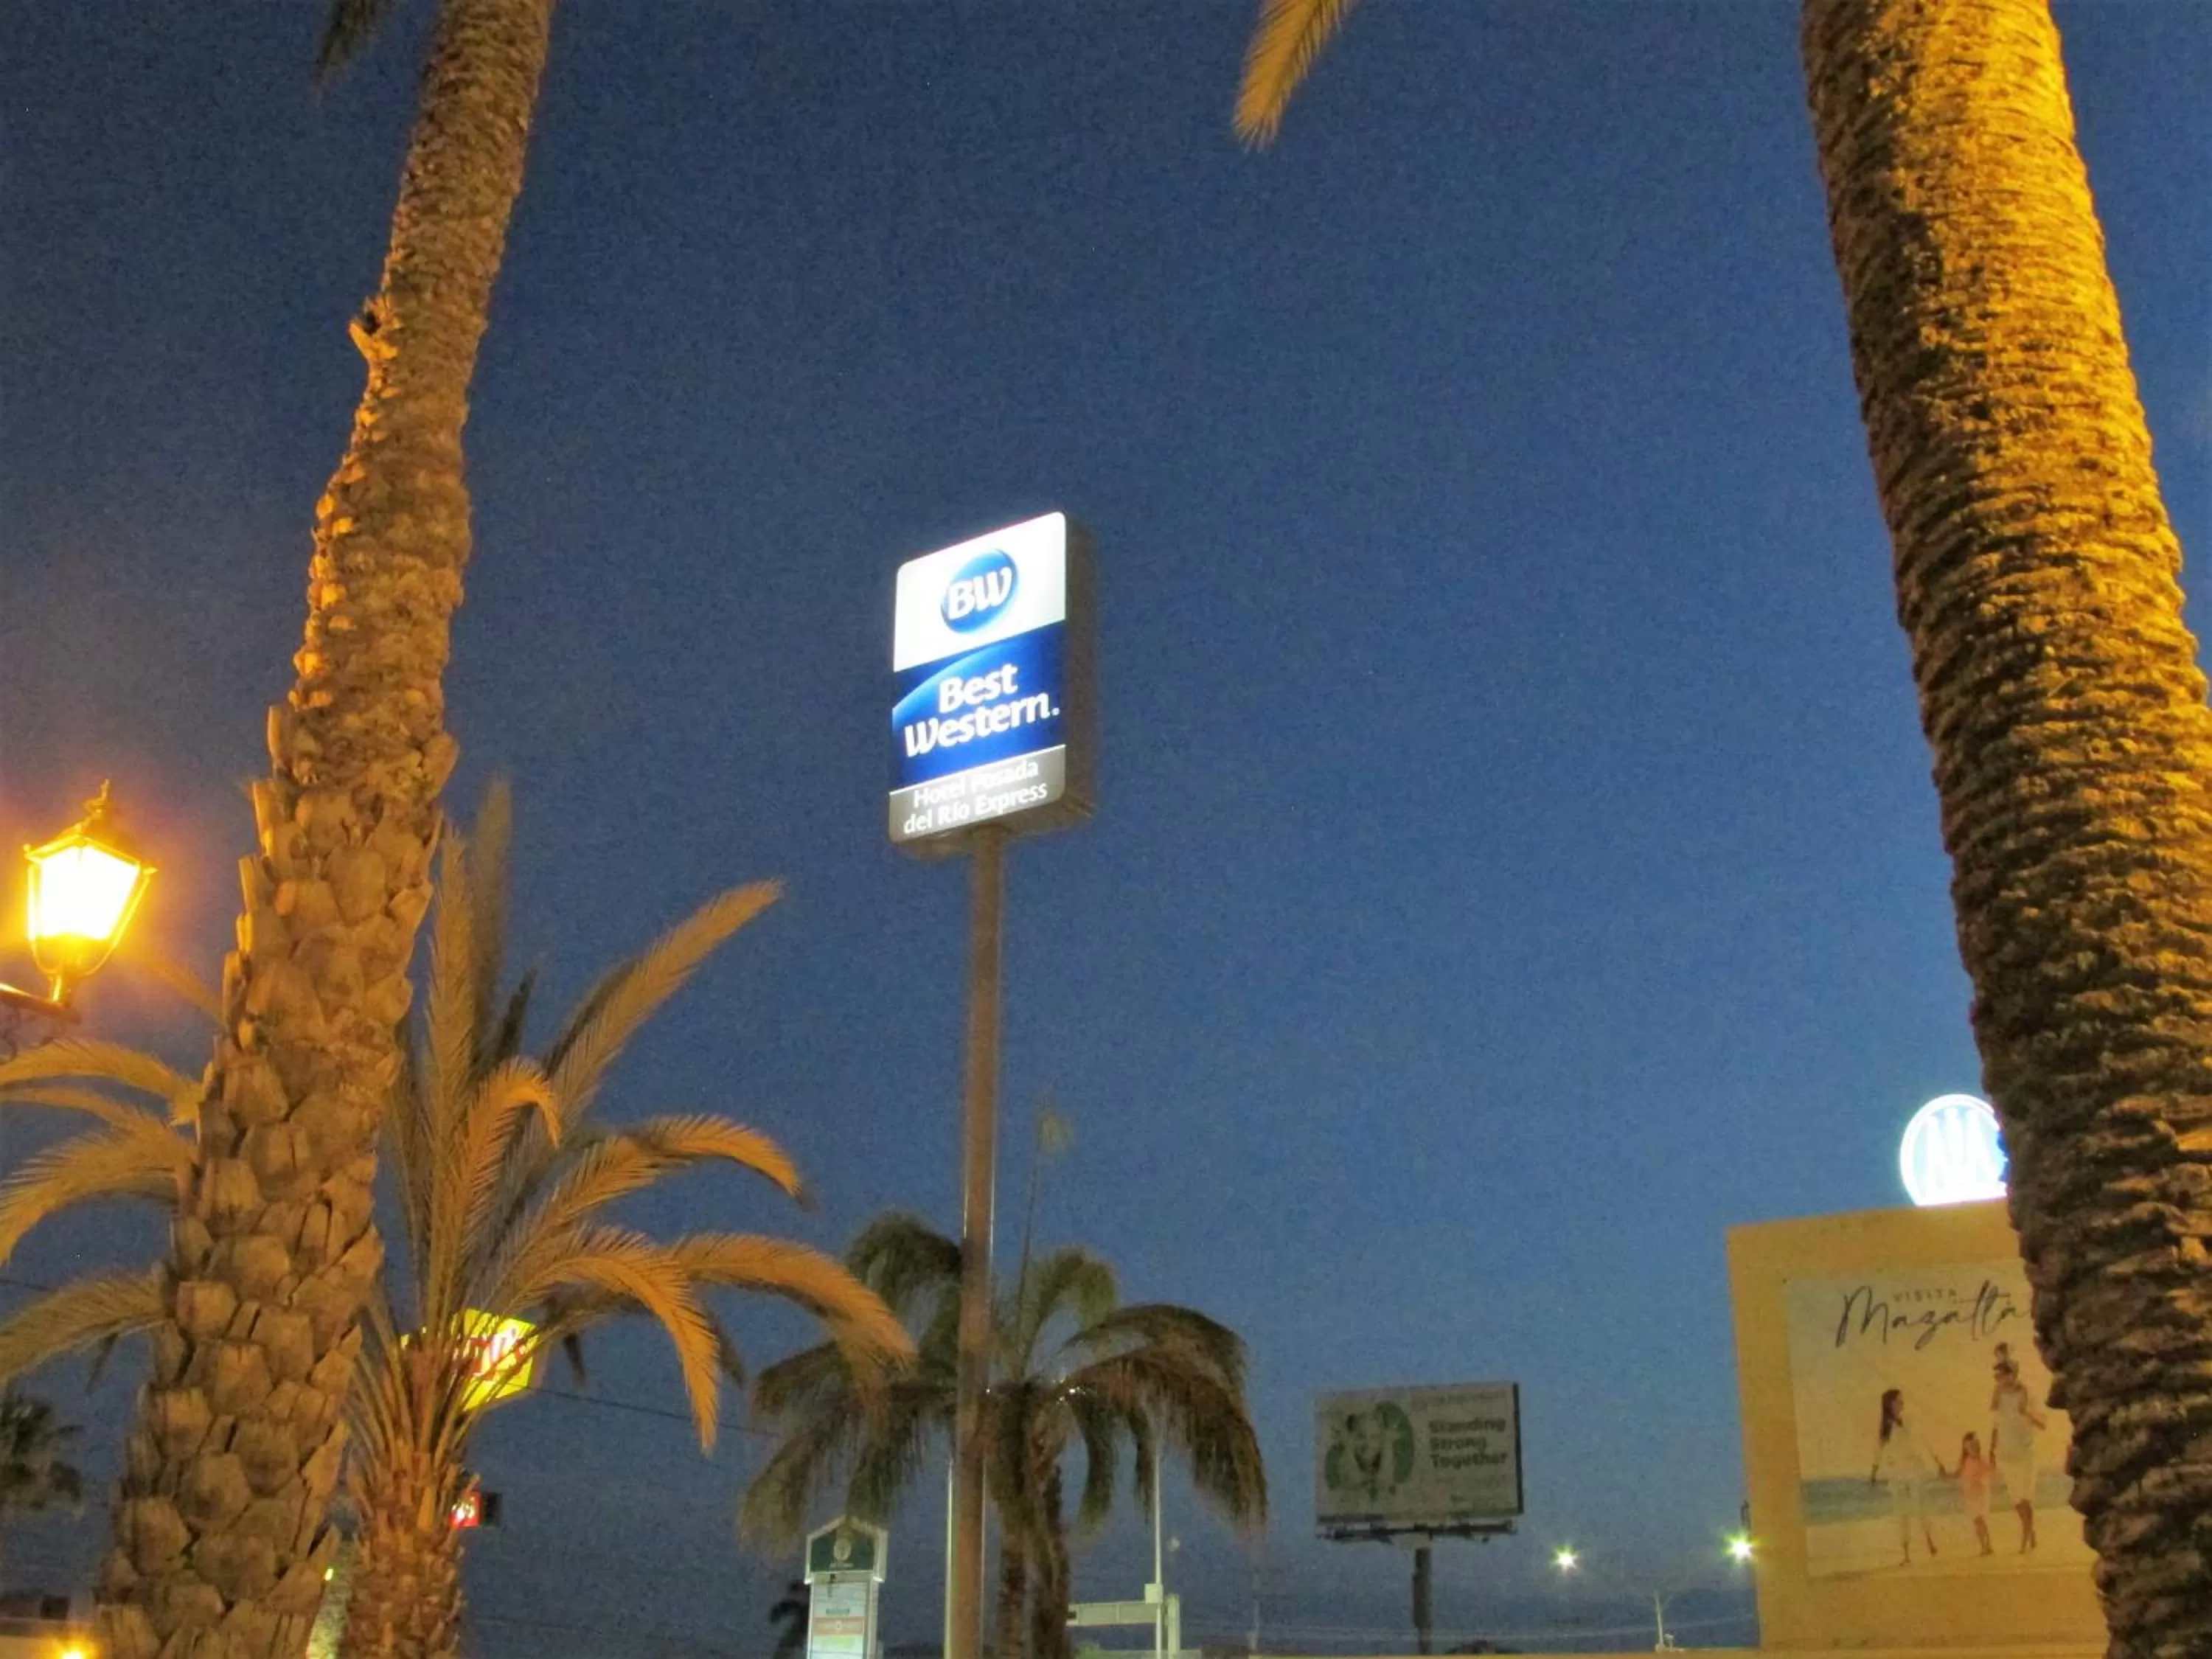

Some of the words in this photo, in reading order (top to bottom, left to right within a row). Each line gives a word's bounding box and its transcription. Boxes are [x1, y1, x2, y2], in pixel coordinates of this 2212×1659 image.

[947, 566, 1013, 620] BW
[939, 664, 1018, 714] Best
[914, 775, 966, 808] Hotel
[903, 808, 933, 834] del
[975, 783, 1048, 815] Express
[1892, 1287, 1958, 1303] VISITA
[1430, 1437, 1487, 1452] Strong
[1430, 1453, 1508, 1470] Together
